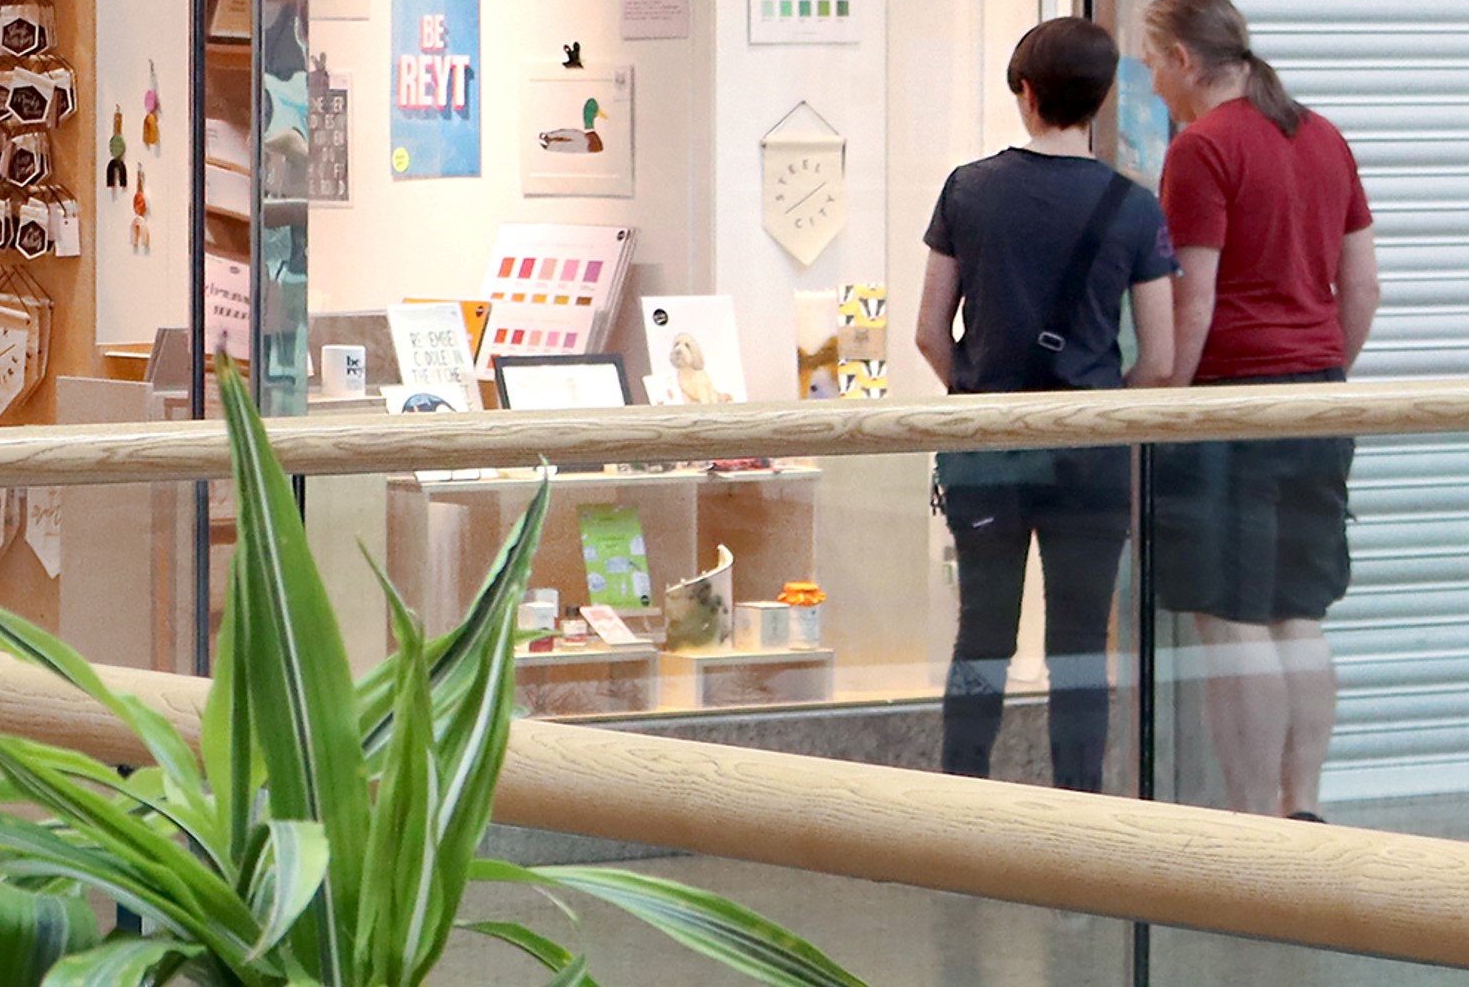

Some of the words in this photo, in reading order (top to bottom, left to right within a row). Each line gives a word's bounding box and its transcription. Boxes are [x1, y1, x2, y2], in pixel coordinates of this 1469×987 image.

[419, 13, 445, 52] BE
[397, 53, 471, 111] REYT
[775, 158, 821, 202] STEEL
[794, 194, 835, 229] CITY
